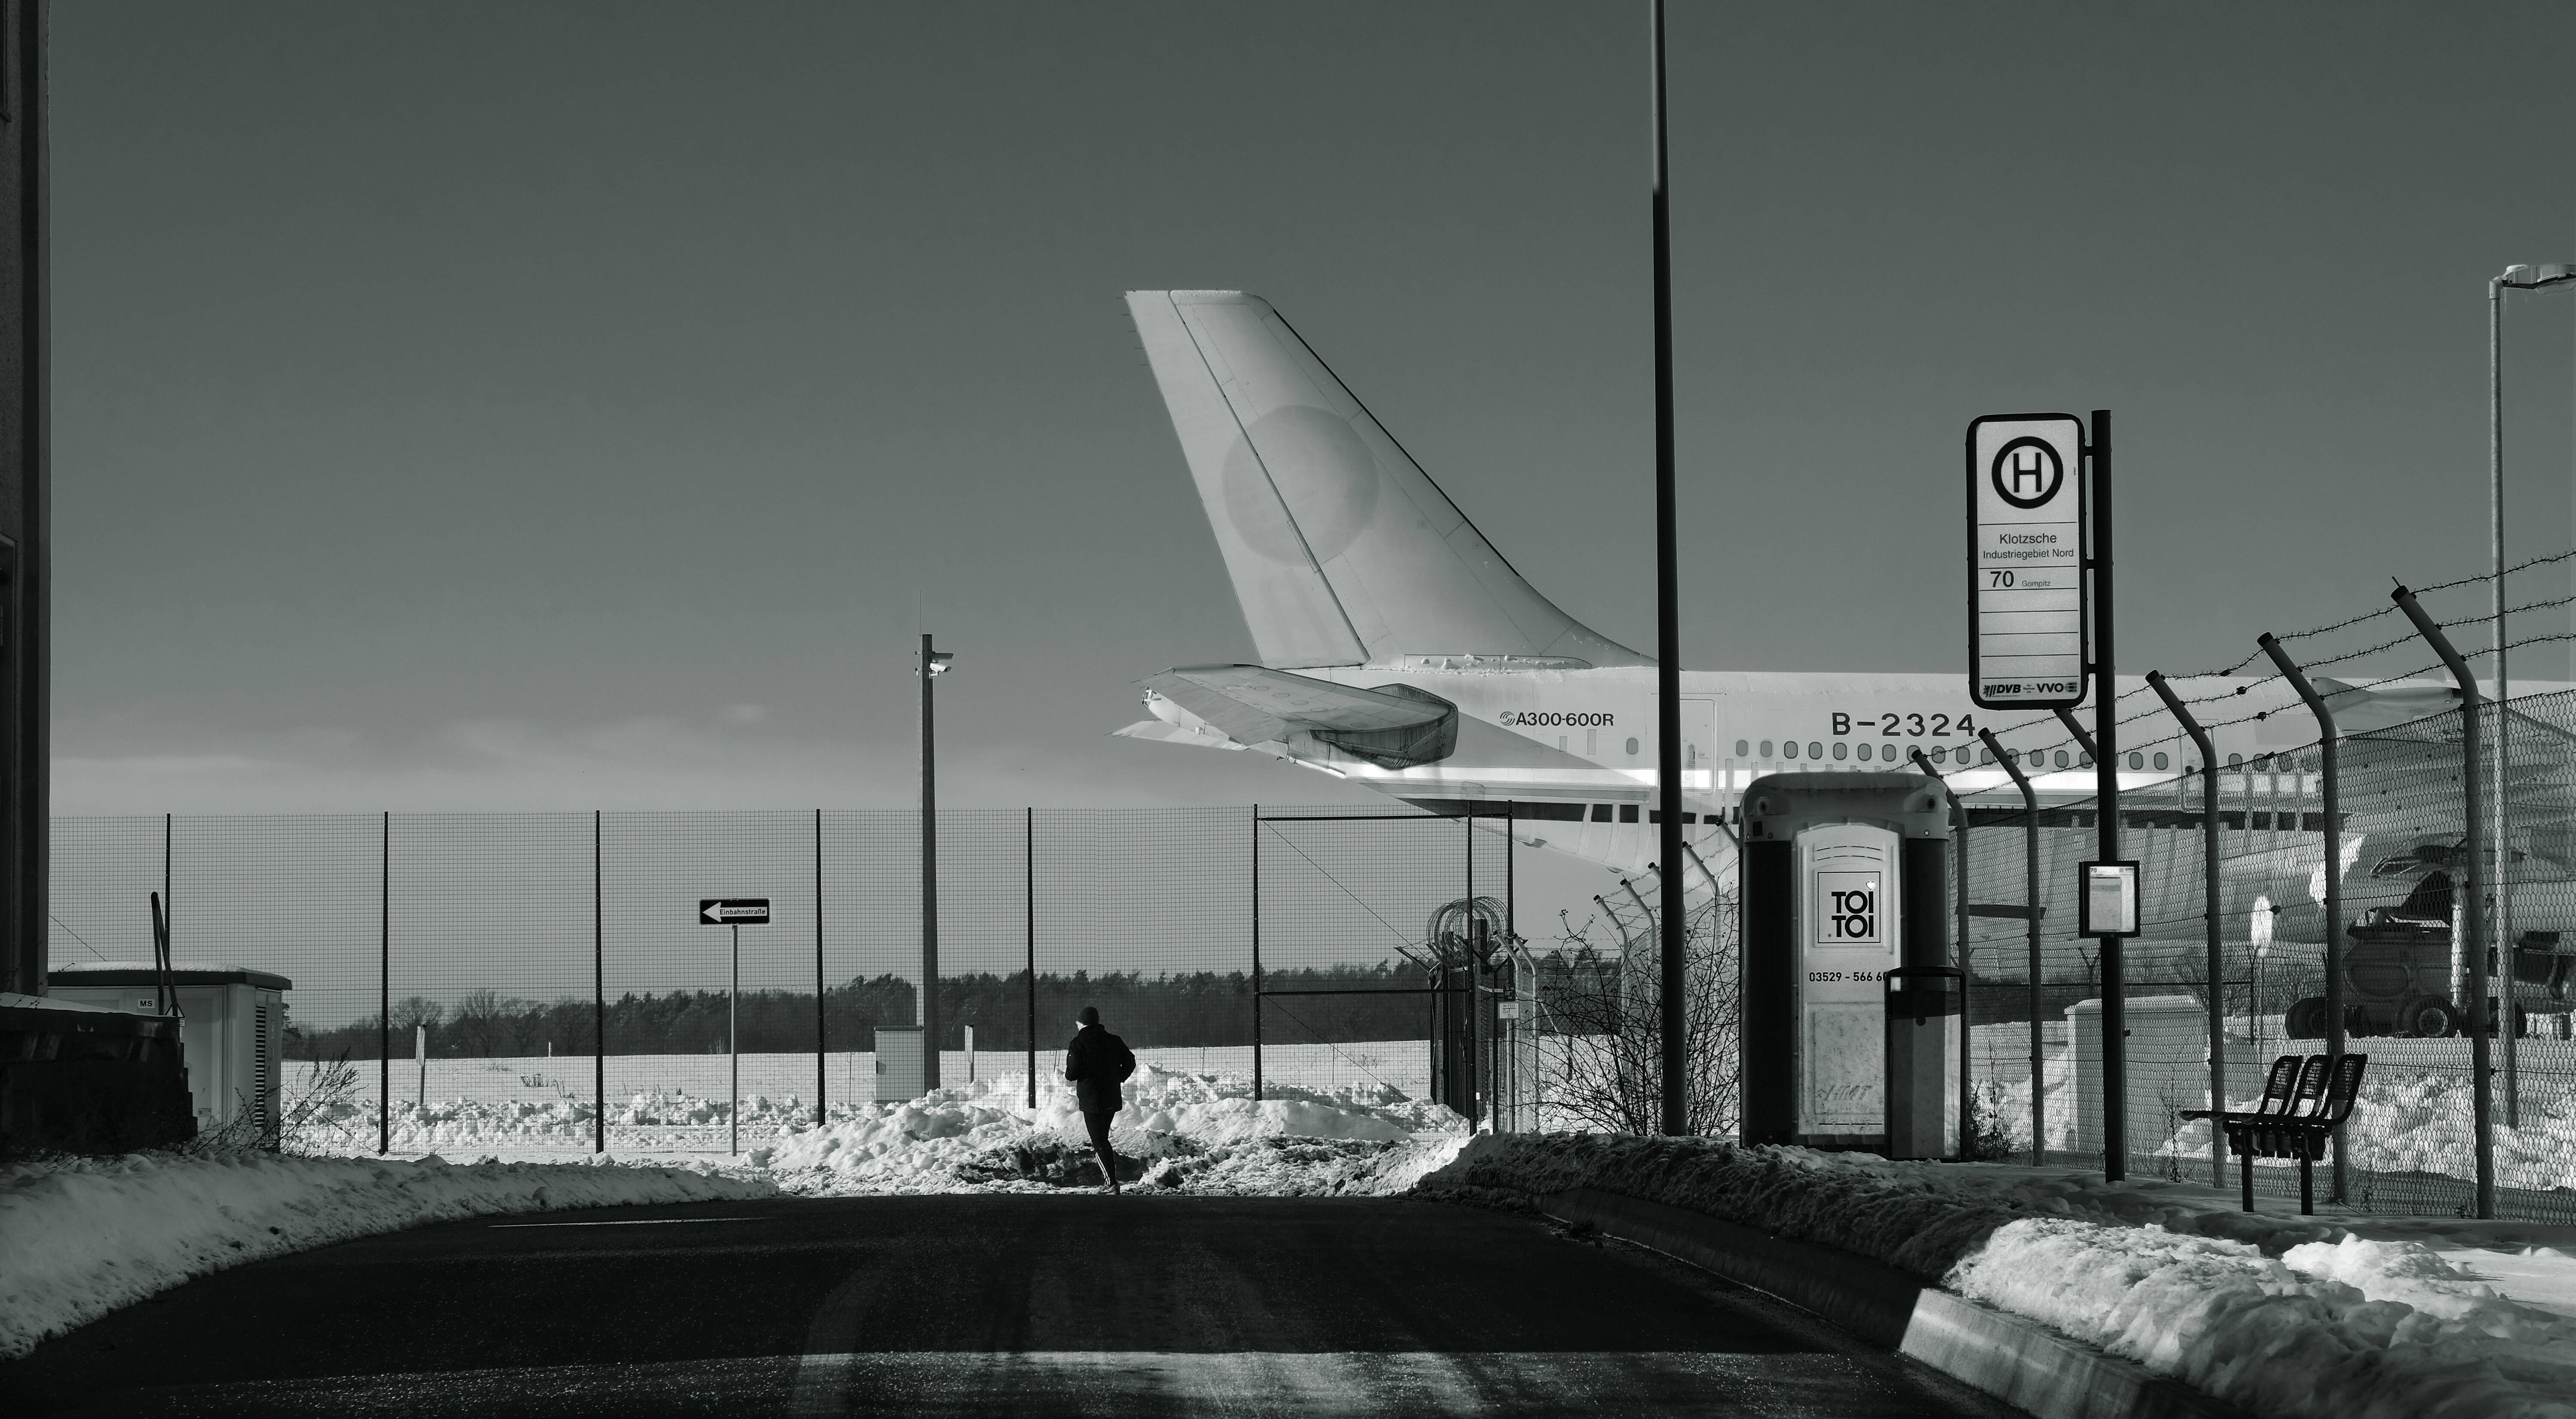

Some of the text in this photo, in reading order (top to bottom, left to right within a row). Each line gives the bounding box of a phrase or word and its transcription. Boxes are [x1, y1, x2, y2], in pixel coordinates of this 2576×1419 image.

[2013, 452, 2042, 493] H
[1999, 533, 2057, 544] Klotzsche
[1983, 549, 2074, 560] Industriegebiet Nord
[1990, 571, 2014, 587] 70
[1996, 684, 2021, 693] DVB
[2036, 683, 2064, 693] VVO
[1516, 712, 1614, 726] A300-600R
[1832, 712, 1975, 737] B-2324
[1831, 890, 1874, 914] TOI
[1831, 915, 1874, 938] TOI
[1809, 972, 1842, 981] 03529
[1853, 972, 1873, 981] 566
